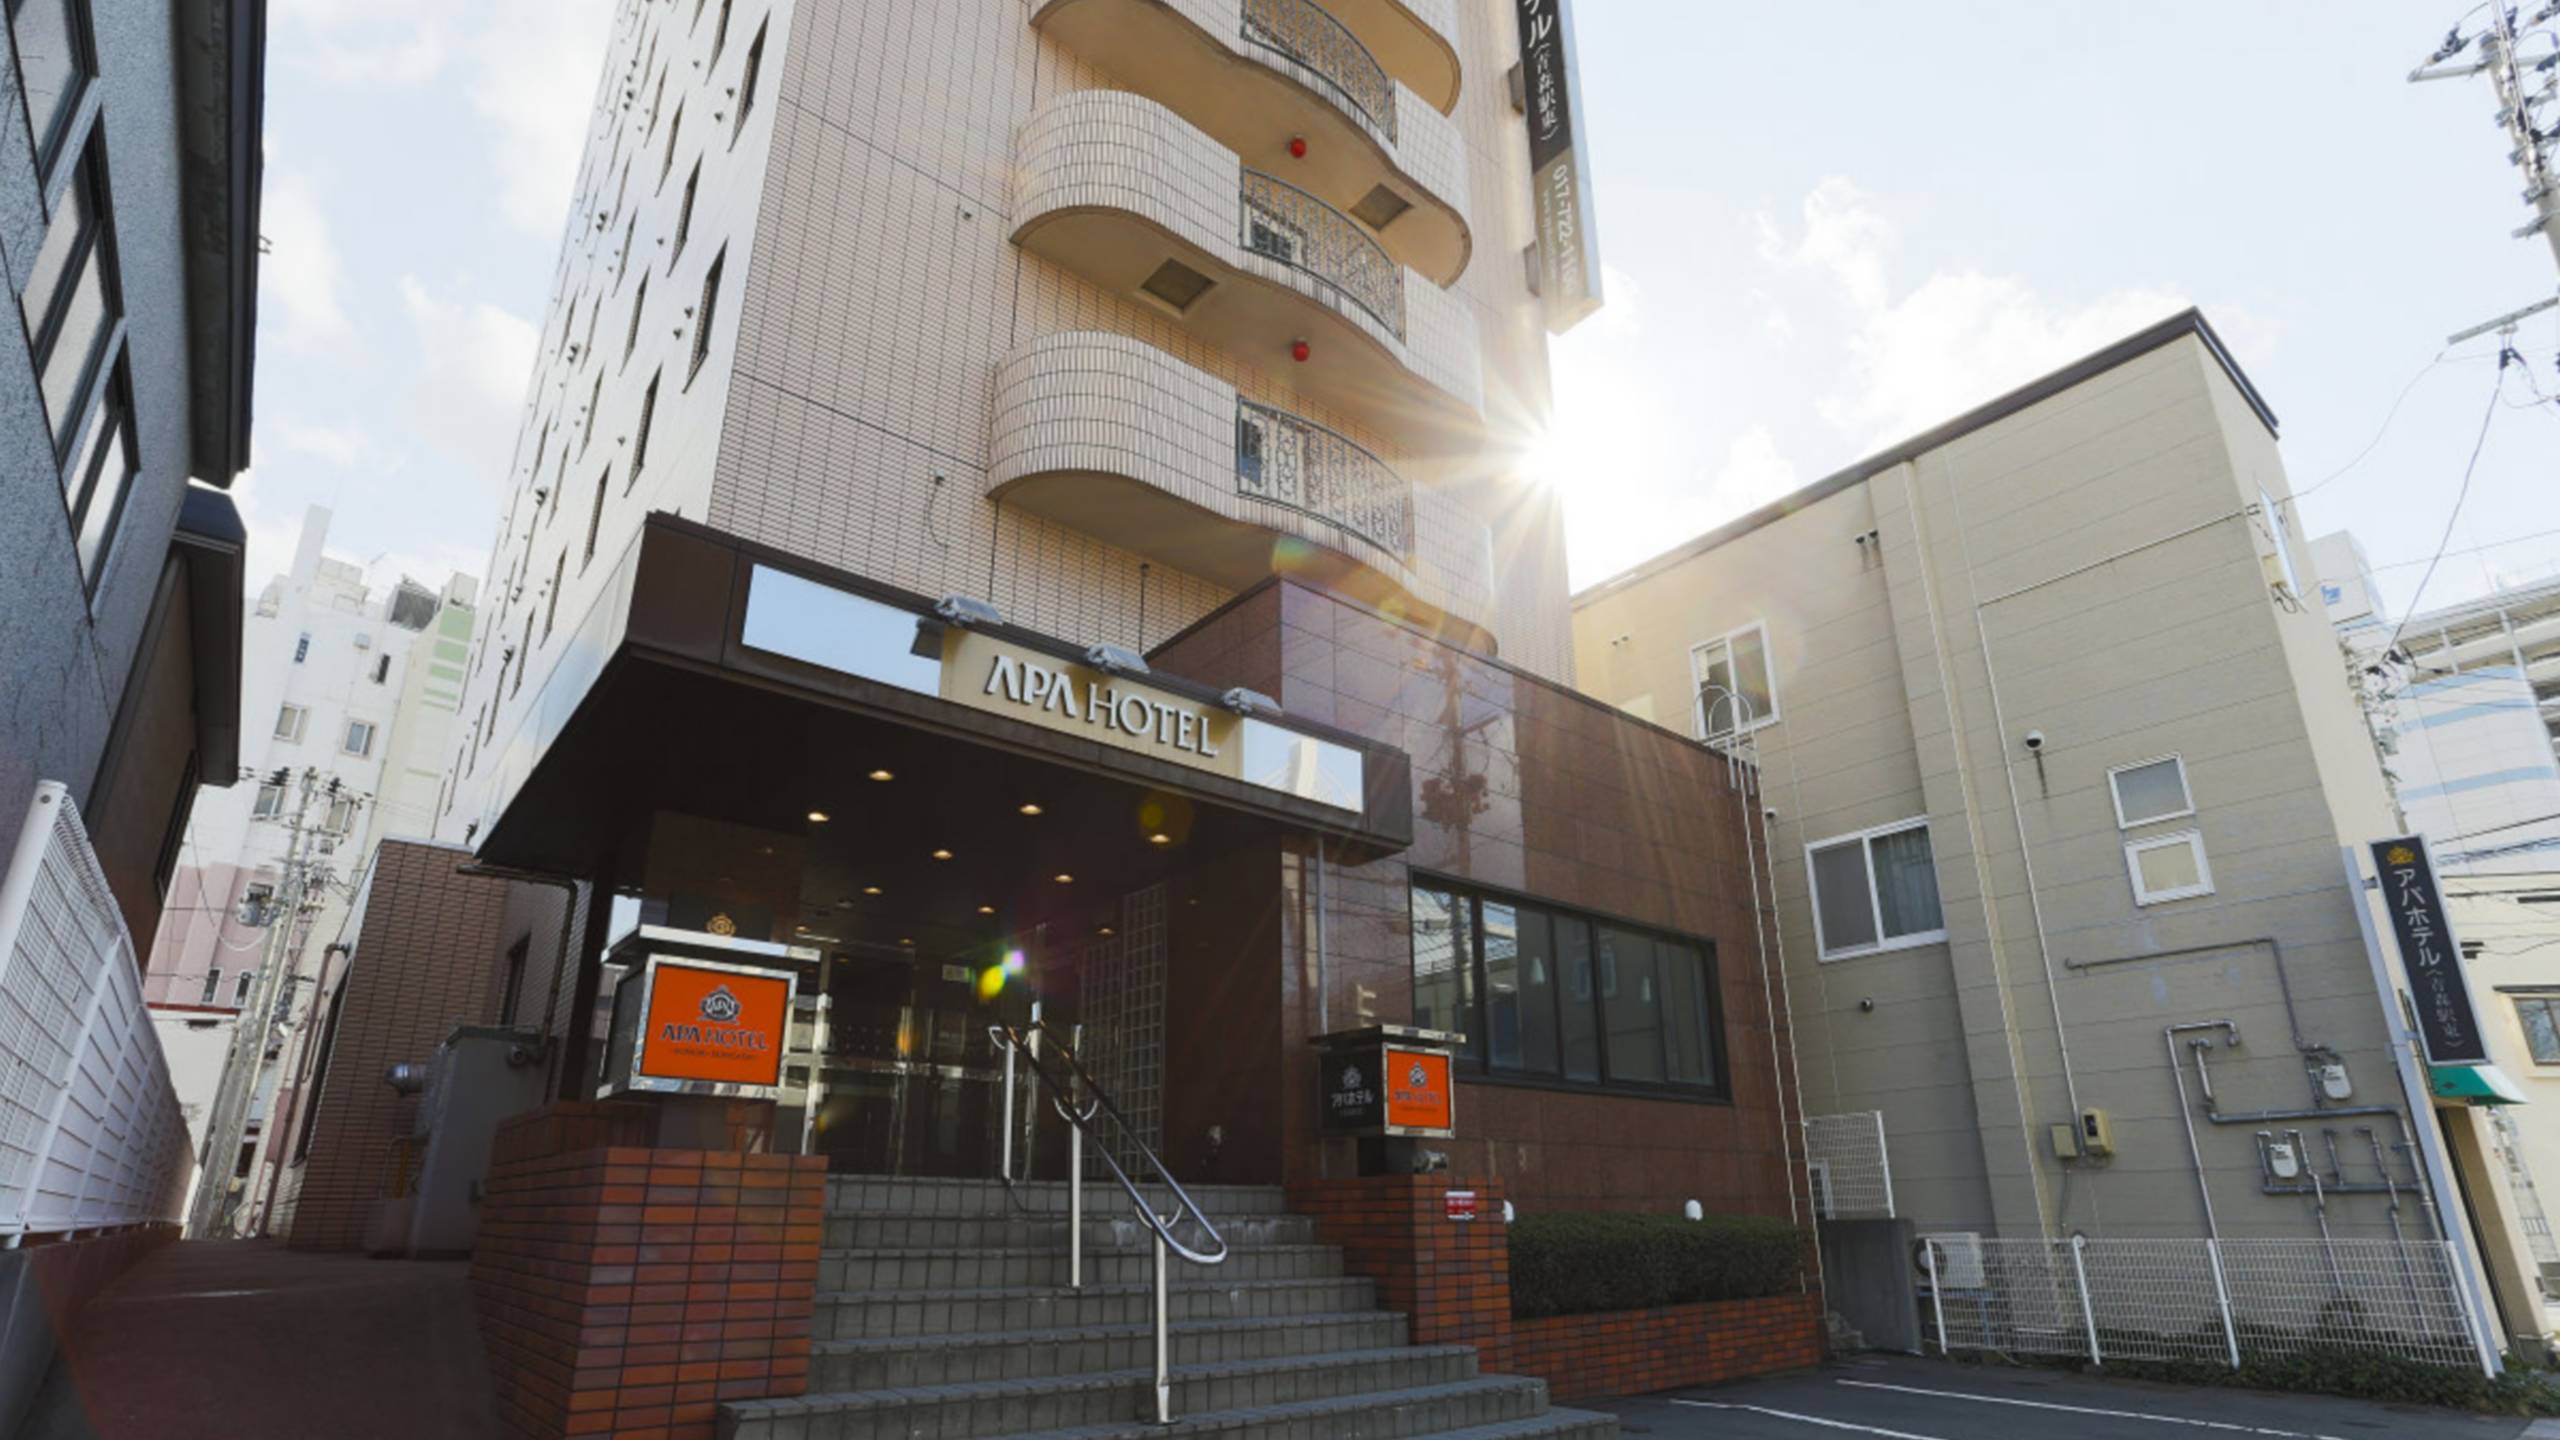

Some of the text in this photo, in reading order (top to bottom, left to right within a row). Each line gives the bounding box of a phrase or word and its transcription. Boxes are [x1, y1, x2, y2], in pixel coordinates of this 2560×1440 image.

[985, 655, 1219, 757] APA HOTEL
[661, 1024, 768, 1051] APA HOTEL
